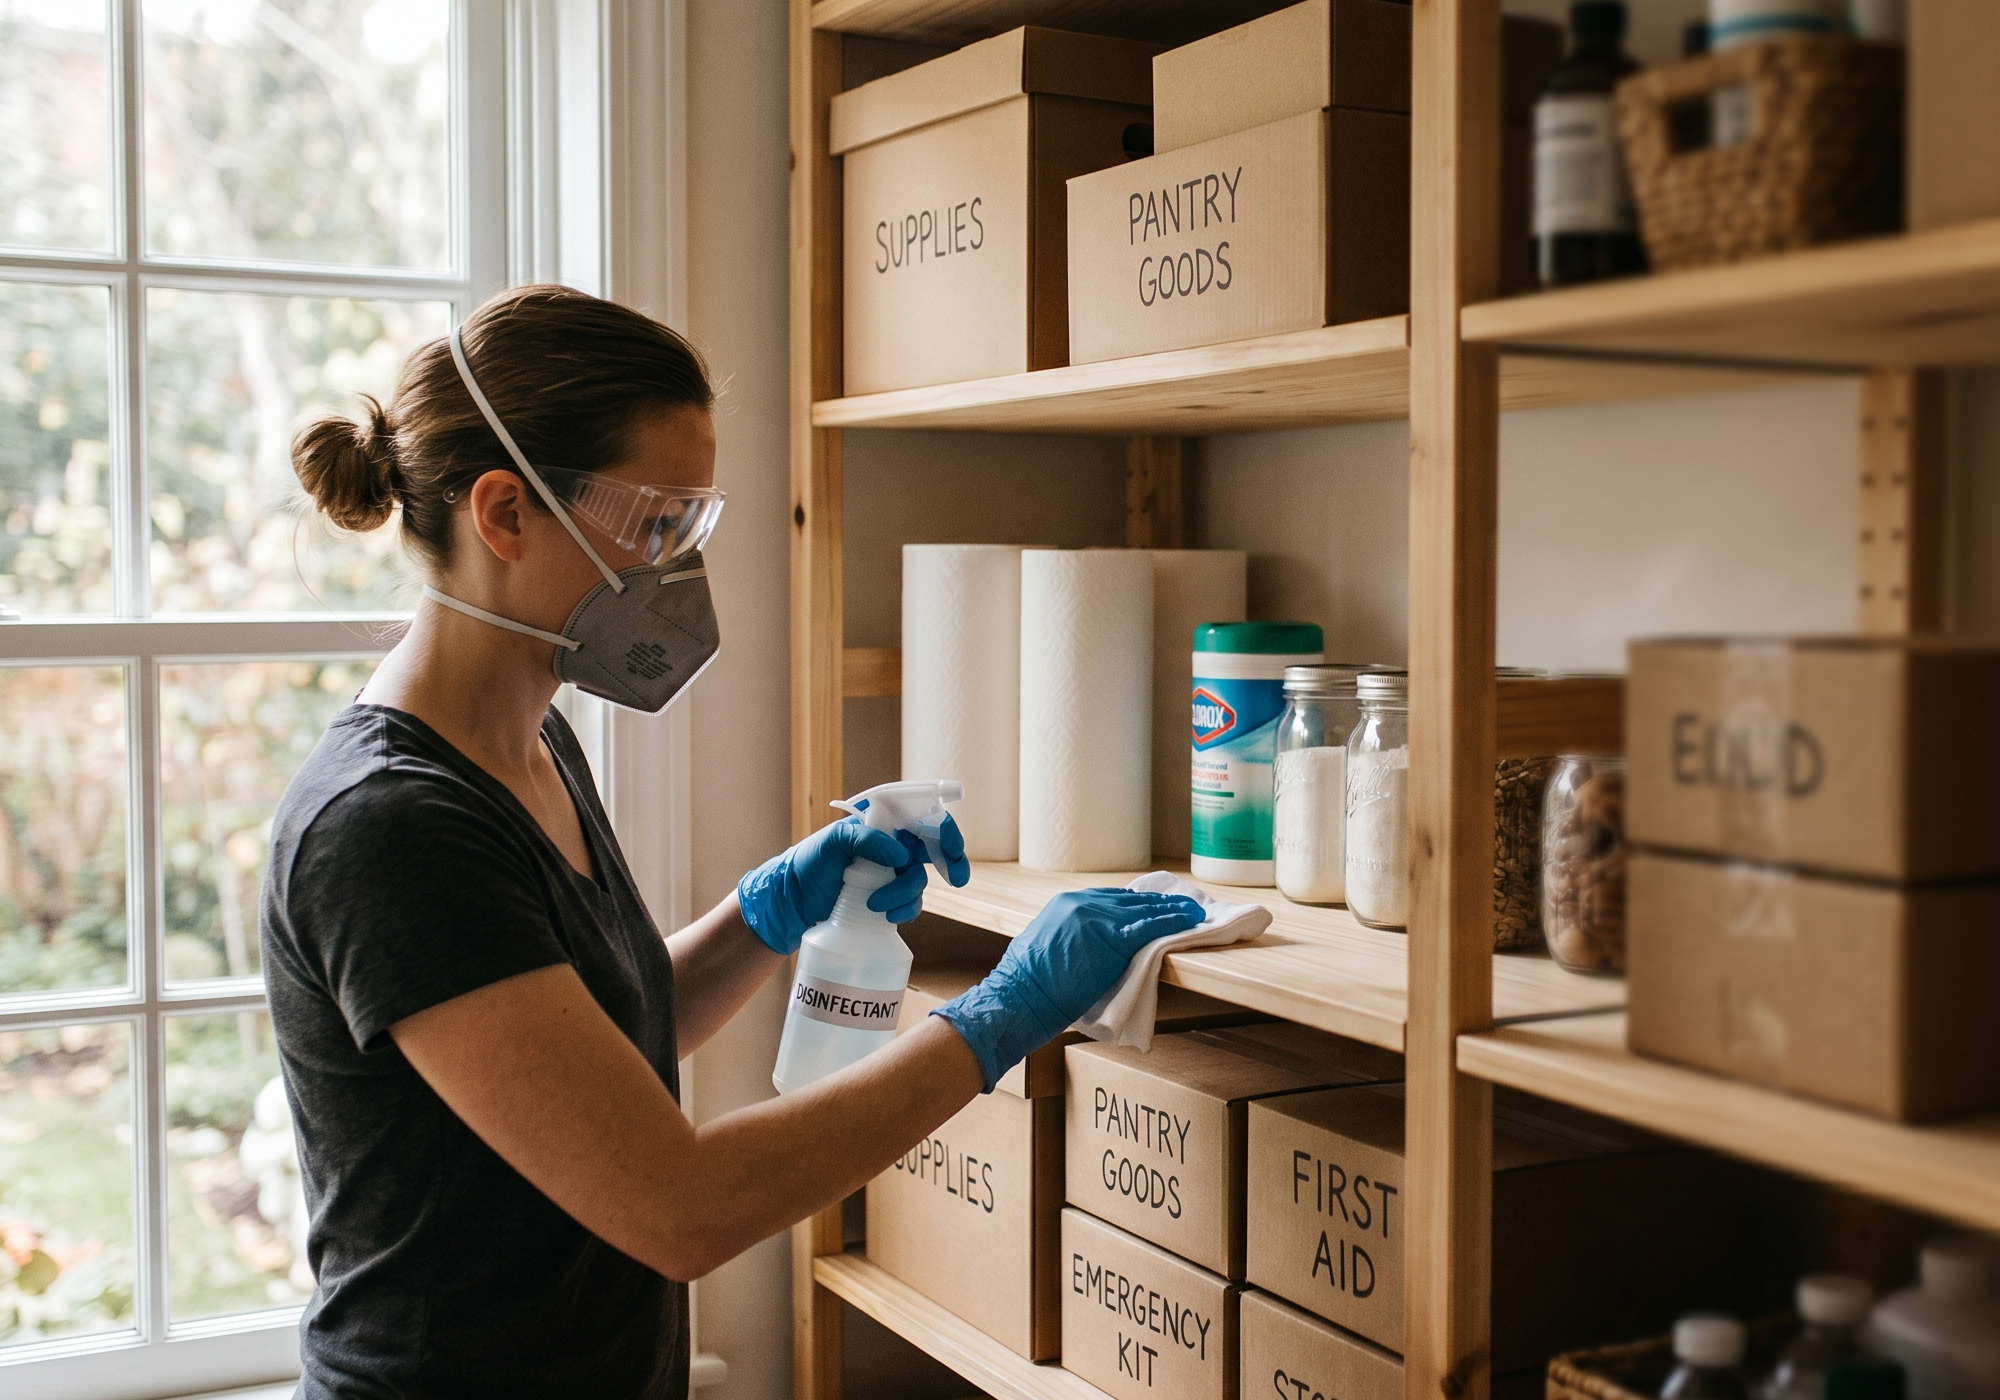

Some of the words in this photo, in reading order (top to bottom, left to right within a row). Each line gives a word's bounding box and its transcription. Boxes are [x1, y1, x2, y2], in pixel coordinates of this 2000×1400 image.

[876, 197, 984, 273] SUPPLIES
[1130, 166, 1242, 245] PANTRY
[1139, 241, 1232, 307] GOODS
[797, 983, 898, 1018] DISINFECTANT
[1095, 1087, 1190, 1164] PANTRY
[1103, 1149, 1182, 1219] GOODS
[1293, 1150, 1397, 1238] FIRST
[1312, 1231, 1375, 1298] AID
[1073, 1253, 1210, 1360] EMERGENCY
[1118, 1332, 1158, 1387] KIT
